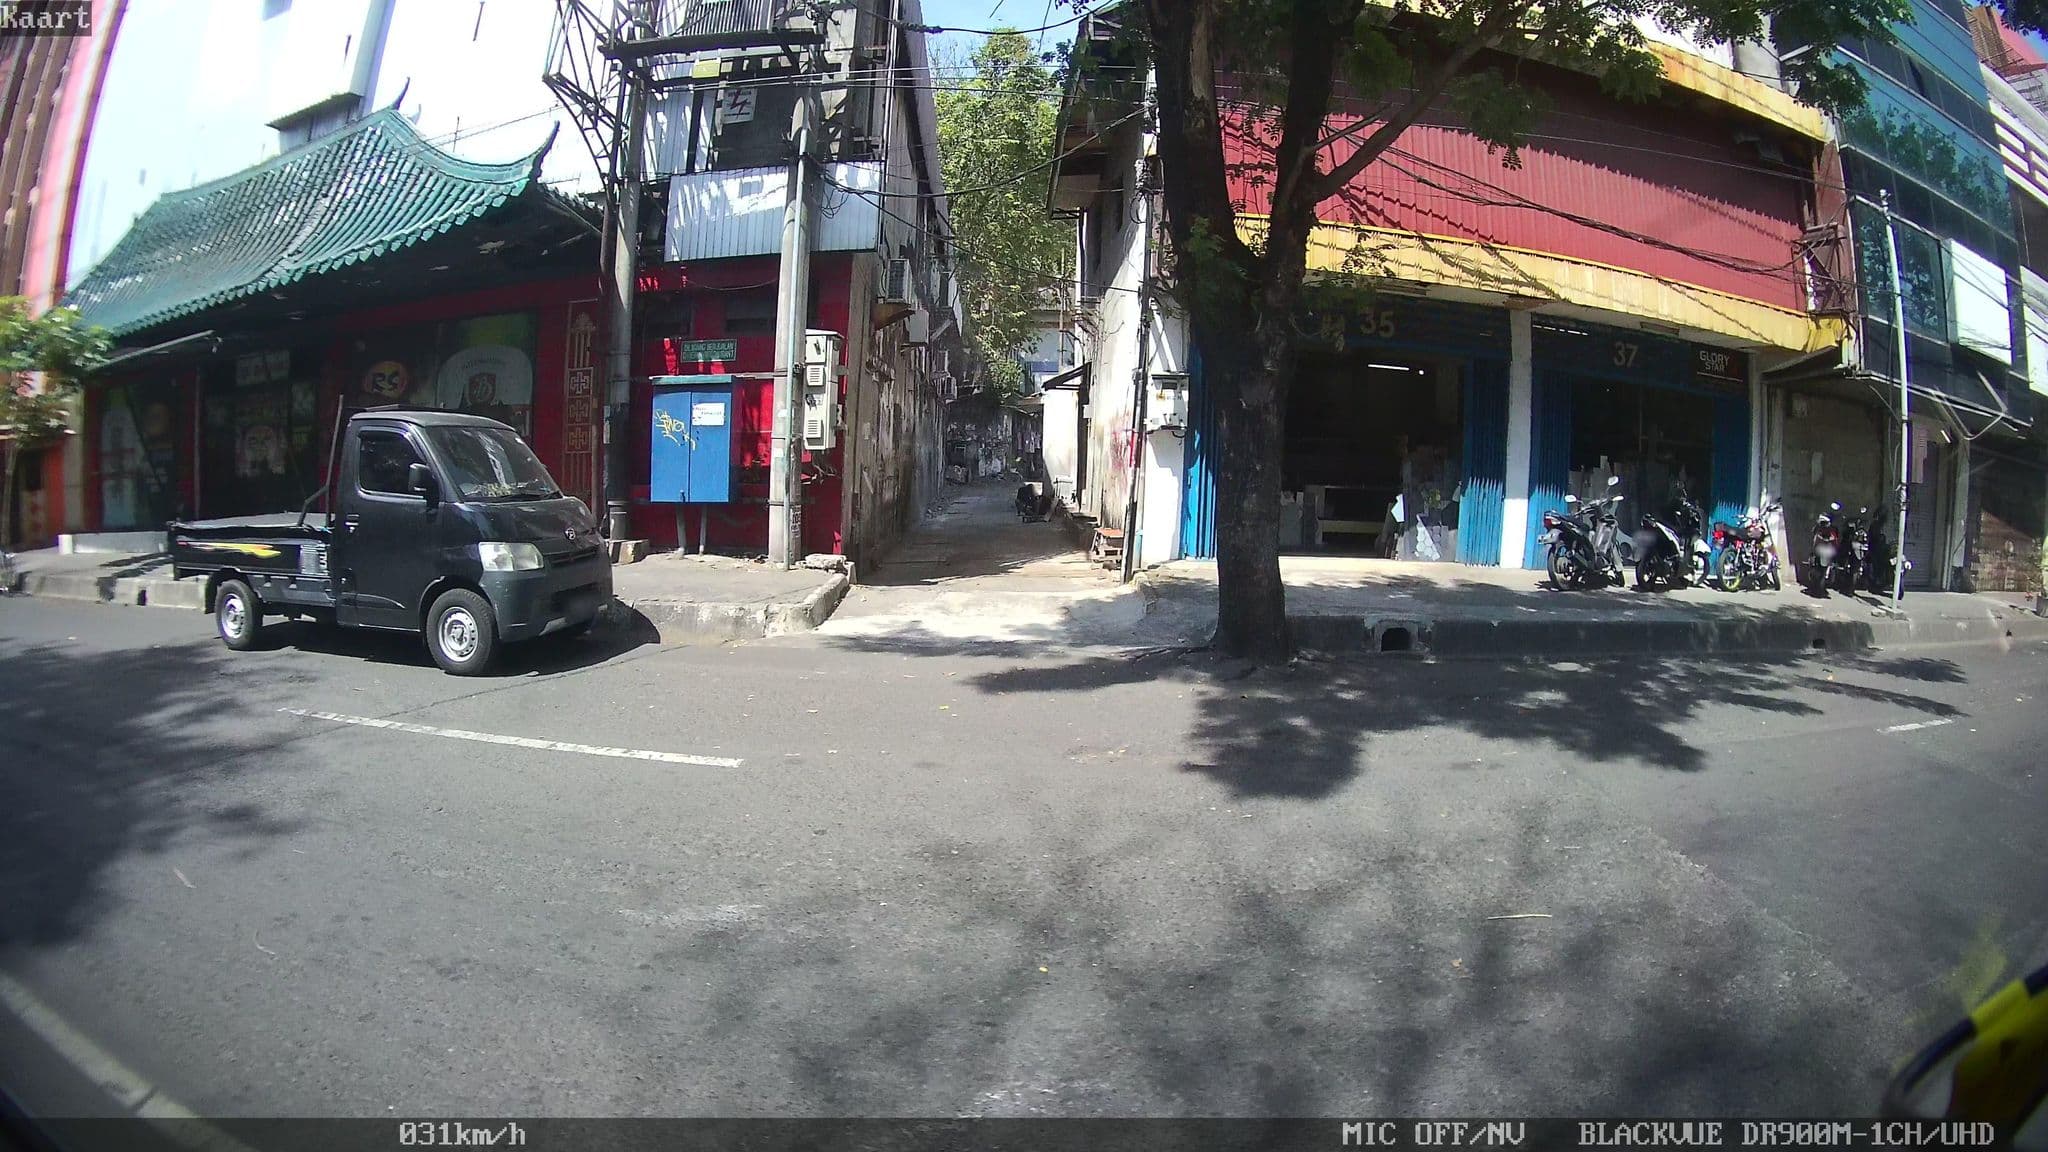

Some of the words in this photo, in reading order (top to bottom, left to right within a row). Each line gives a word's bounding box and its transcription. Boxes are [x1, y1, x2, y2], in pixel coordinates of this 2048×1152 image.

[1613, 342, 1639, 368] 37
[1699, 350, 1730, 367] GLORY
[1705, 361, 1725, 373] STAR
